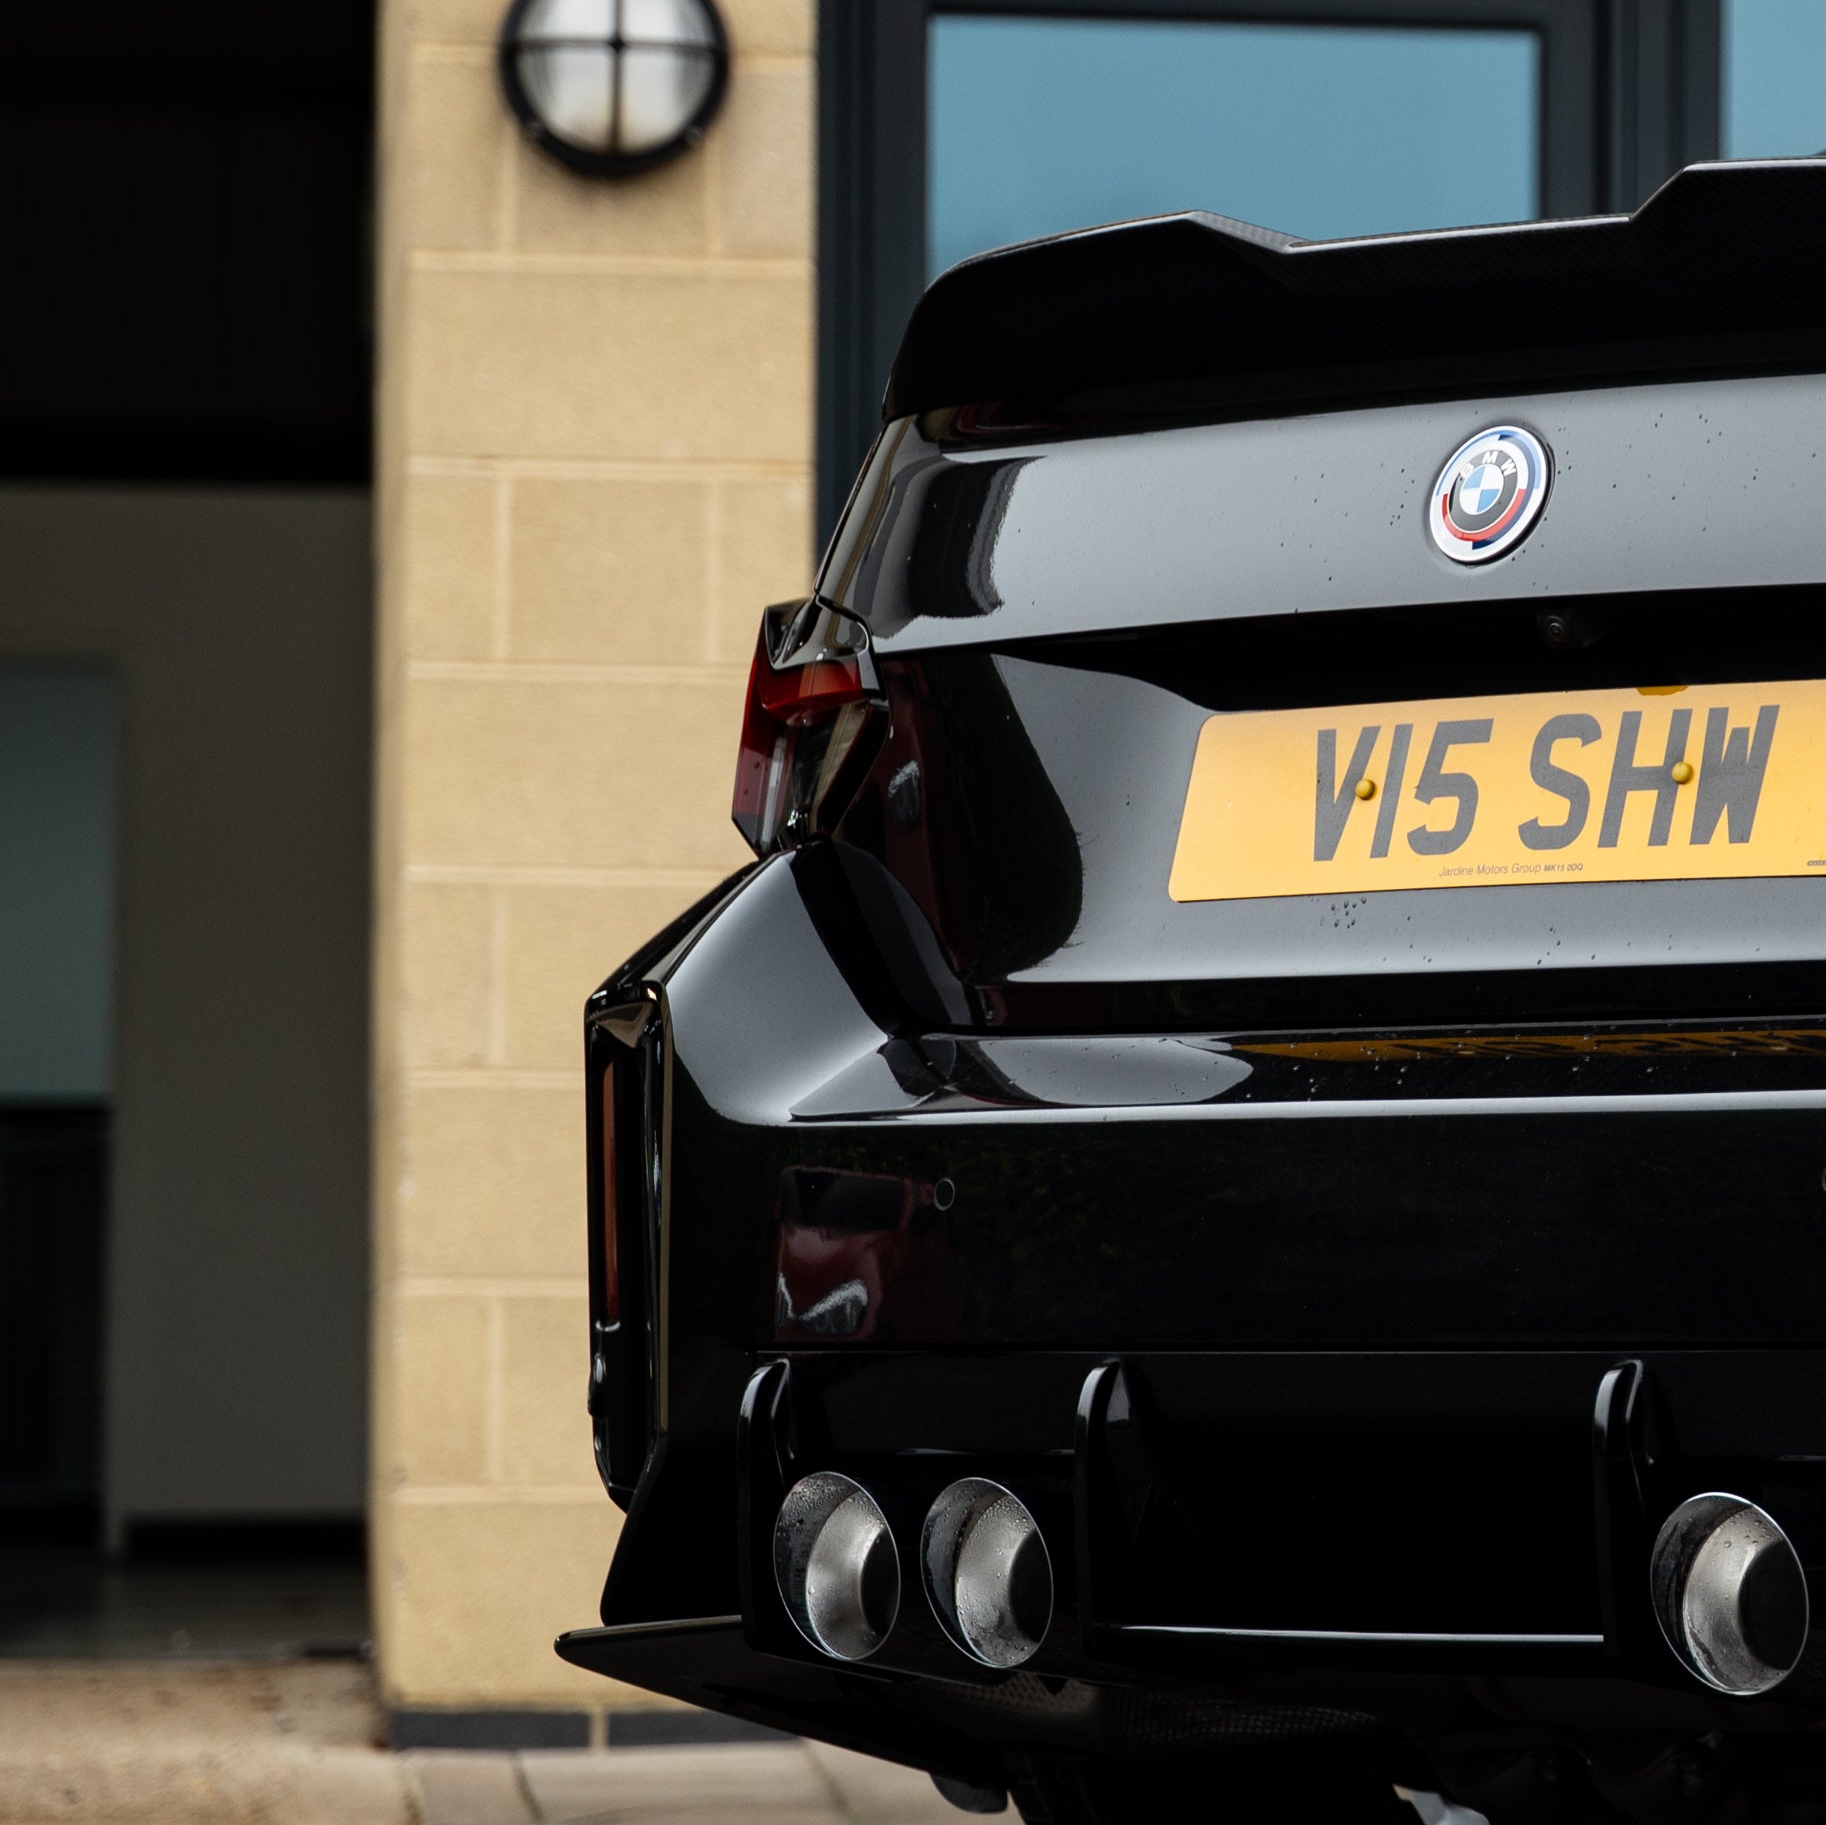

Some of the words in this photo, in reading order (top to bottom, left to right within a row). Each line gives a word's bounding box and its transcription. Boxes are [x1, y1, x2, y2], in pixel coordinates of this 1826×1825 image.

[1460, 450, 1518, 479] BMW
[1312, 717, 1495, 863] V15
[1517, 704, 1782, 851] SHW
[1439, 865, 1473, 877] Jardine
[1476, 864, 1508, 875] Motors
[1511, 862, 1541, 875] Group
[1544, 863, 1565, 872] MK15
